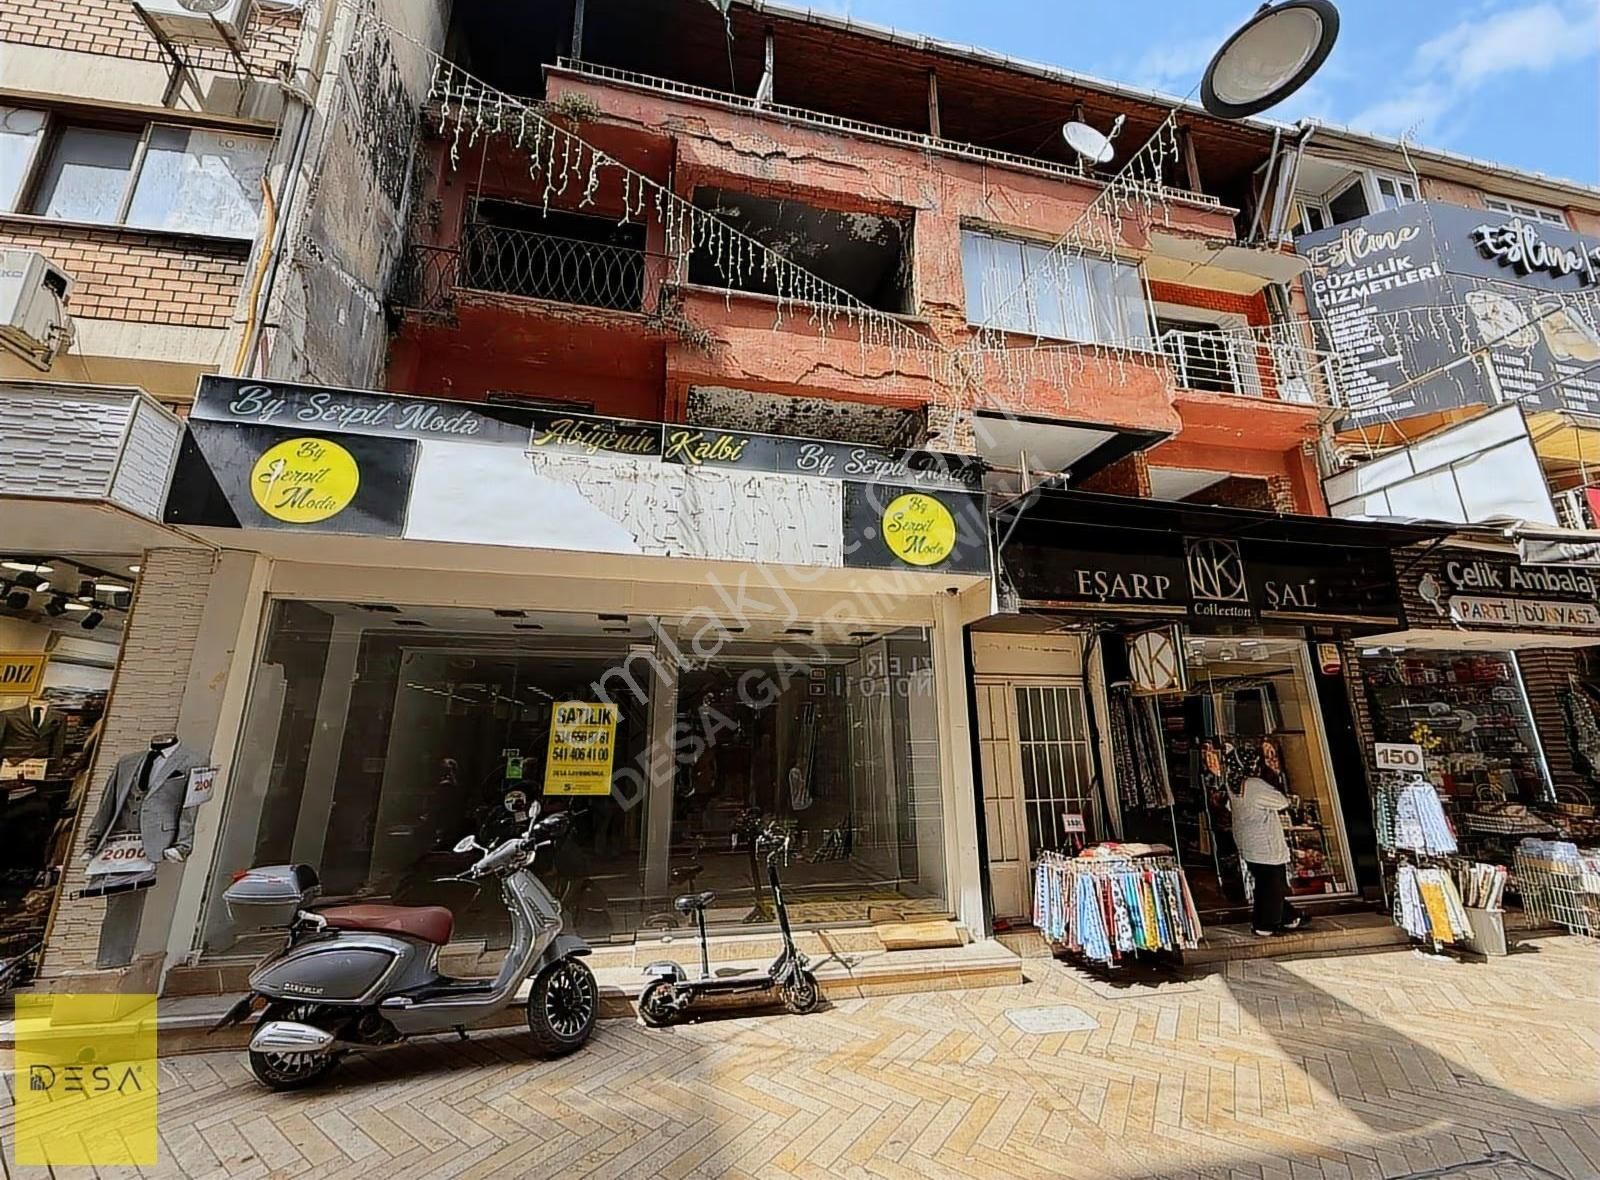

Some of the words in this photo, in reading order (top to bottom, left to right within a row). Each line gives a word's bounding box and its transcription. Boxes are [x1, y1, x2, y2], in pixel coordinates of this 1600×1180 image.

[1312, 256, 1414, 293] GÜZELLİK
[230, 386, 284, 420] By
[297, 394, 390, 434] Serpil
[394, 405, 481, 436] Moda
[297, 441, 325, 462] By
[665, 430, 749, 465] Kalbi
[796, 444, 835, 475] By
[844, 449, 907, 481] Serpil
[274, 486, 338, 510] Moda
[909, 497, 928, 514] By
[903, 535, 949, 556] Moda
[1075, 569, 1170, 602] EŞARP
[1264, 580, 1317, 610] ŞAL
[1447, 561, 1503, 591] Çelik
[1510, 565, 1598, 600] Ambalaj
[1194, 602, 1251, 617] Collection
[1461, 600, 1510, 621] PARTİ
[1520, 602, 1595, 625] DÜNYASI
[557, 707, 611, 725] SATILIK
[1378, 750, 1420, 766] 150
